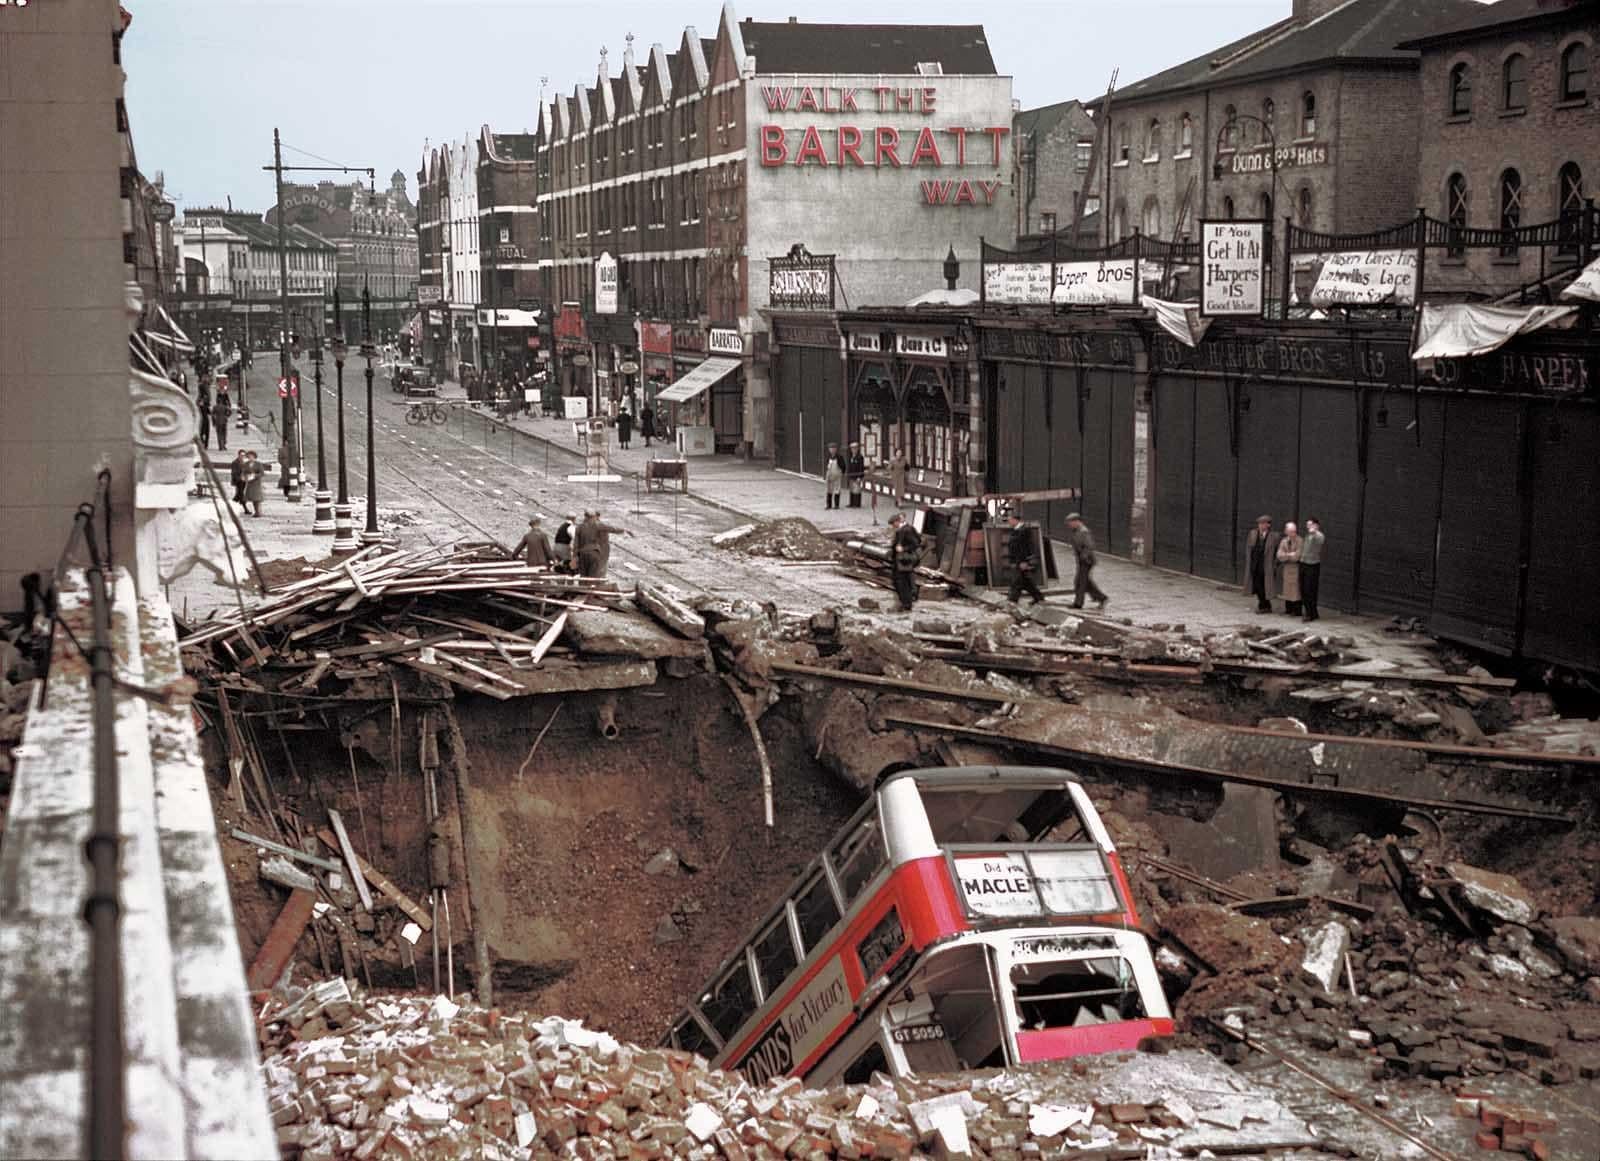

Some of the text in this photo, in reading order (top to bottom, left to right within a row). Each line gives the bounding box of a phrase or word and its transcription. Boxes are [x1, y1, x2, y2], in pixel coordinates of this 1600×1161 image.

[762, 86, 936, 113] WALK THE
[760, 125, 1010, 168] BARRATT
[1298, 148, 1325, 165] Hats
[920, 180, 1002, 206] WAY
[1228, 226, 1251, 237] You
[1207, 240, 1232, 260] Get
[1236, 240, 1246, 260] It
[1379, 268, 1412, 286] Lace
[1279, 345, 1327, 373] BROS
[788, 1010, 809, 1043] for
[803, 976, 844, 1036] Victory
[894, 1030, 912, 1042] GT
